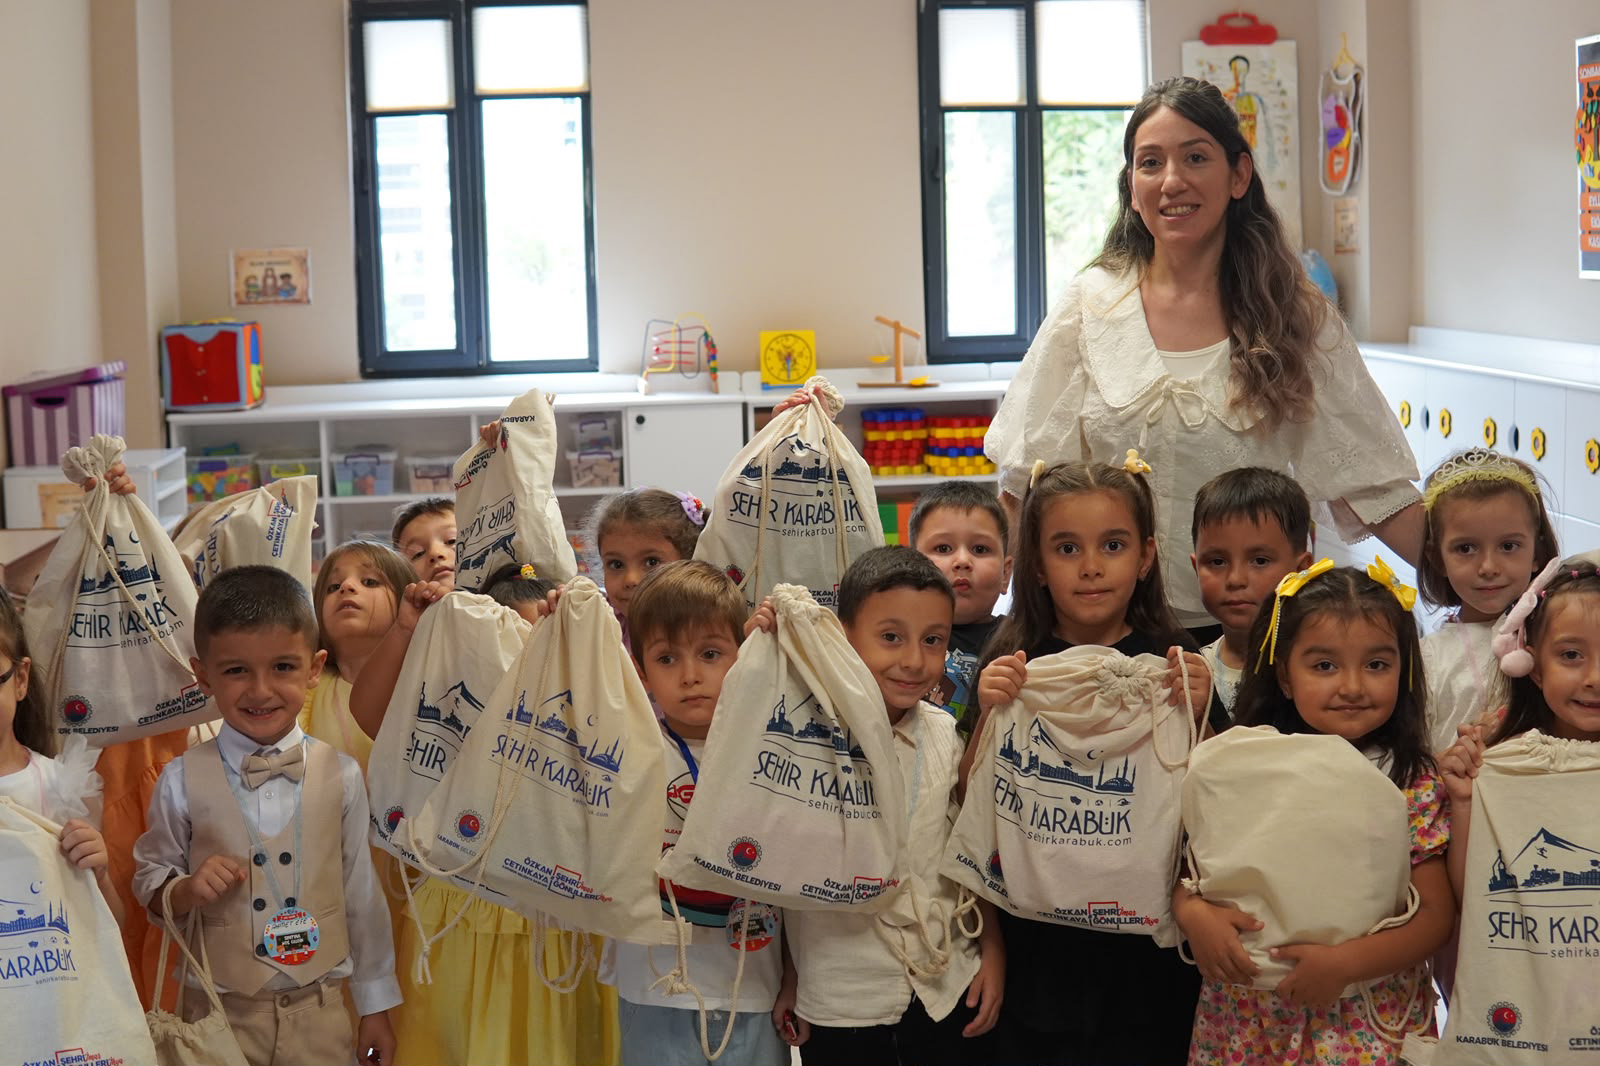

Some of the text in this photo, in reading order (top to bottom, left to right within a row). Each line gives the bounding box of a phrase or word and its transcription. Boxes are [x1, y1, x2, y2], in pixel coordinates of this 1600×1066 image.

[729, 491, 779, 522] ŞEHR
[808, 589, 834, 598] ZKAN
[753, 750, 801, 791] ŞEHİR
[541, 756, 613, 809] KARAÜK
[1030, 800, 1132, 835] KARABÜK
[524, 856, 553, 875] ÖZKAN
[694, 856, 734, 879] KARABÜK
[823, 877, 852, 892] ÖZKAN
[1054, 907, 1088, 917] ÖZKAN
[1456, 1035, 1500, 1047] KARABÜK
